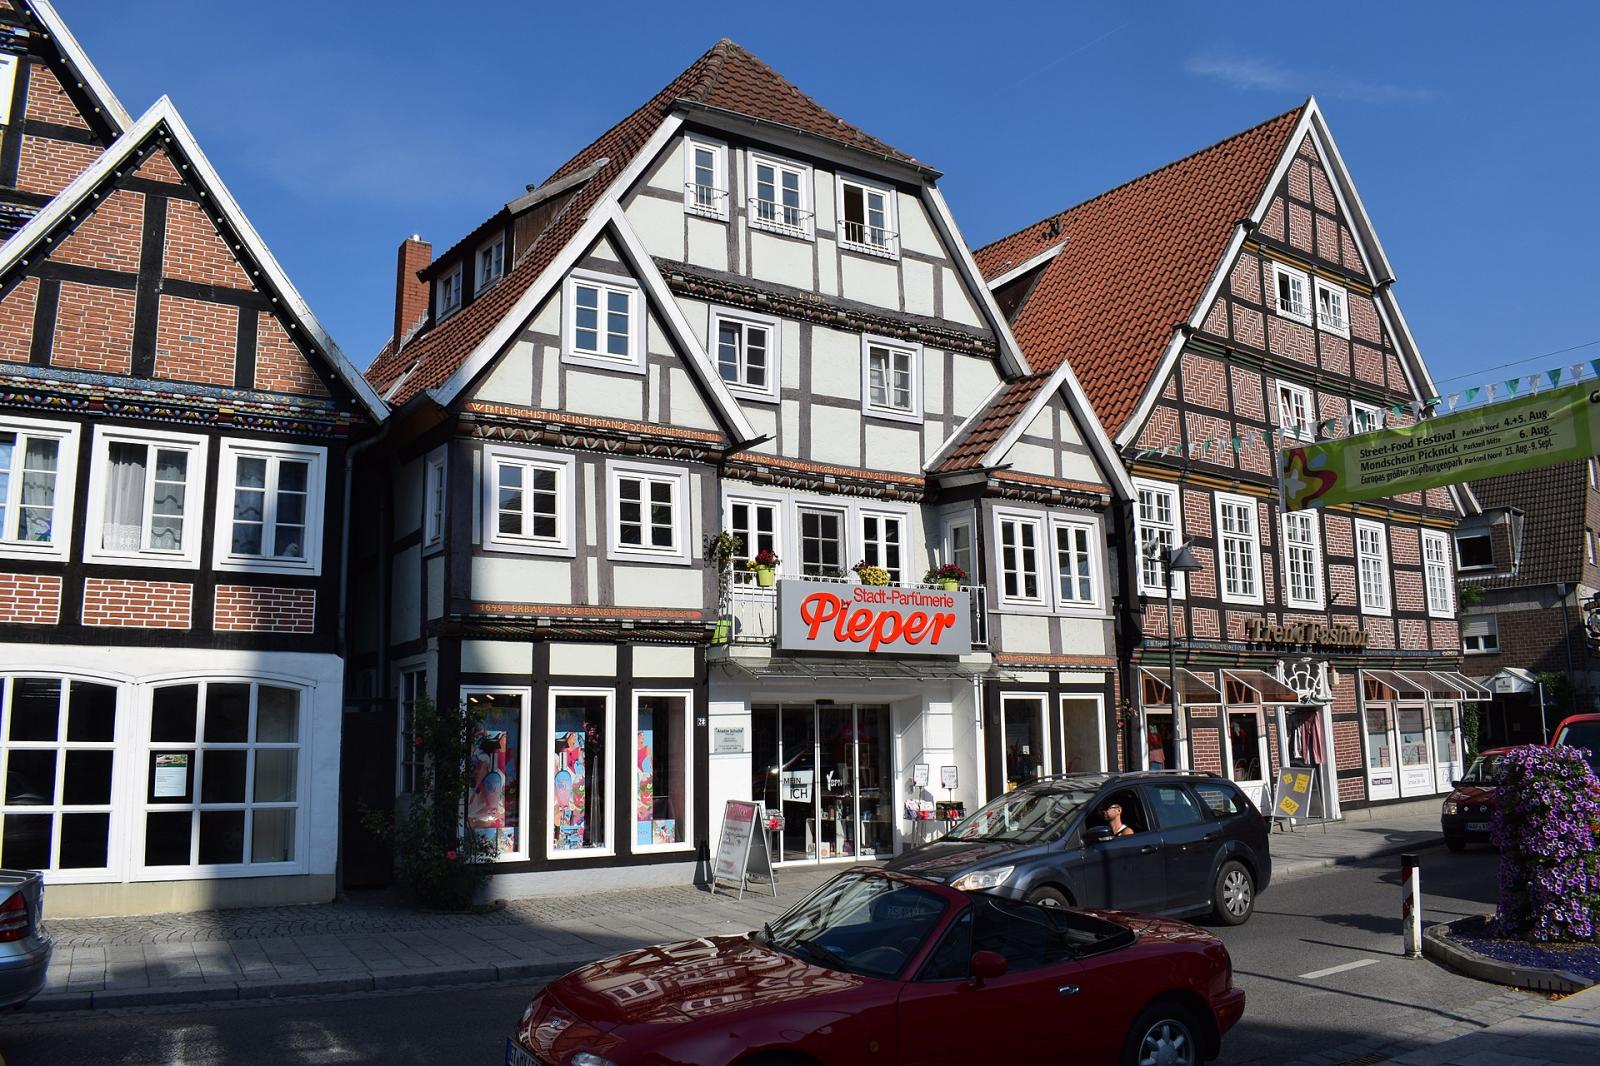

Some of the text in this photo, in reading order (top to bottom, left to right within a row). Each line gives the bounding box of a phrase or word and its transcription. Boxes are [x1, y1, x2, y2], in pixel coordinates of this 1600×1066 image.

[1360, 438, 1414, 459] Street-Food
[1417, 429, 1456, 447] Festival
[1485, 422, 1499, 432] Nord
[1529, 410, 1550, 421] Aug.
[1360, 453, 1416, 472] Mondschein
[1418, 443, 1458, 460] Picknick
[1519, 429, 1528, 439] 6.
[1531, 425, 1552, 436] Aug.
[1361, 474, 1386, 485] Europas
[1410, 457, 1463, 476] Hüpfburgenpark
[1487, 451, 1502, 460] Nord
[853, 587, 954, 608] Stadt-Parfümerie
[800, 591, 957, 654] Pieper
[1309, 622, 1369, 646] Fashion
[783, 777, 802, 785] MEIN
[790, 788, 808, 799] ICH
